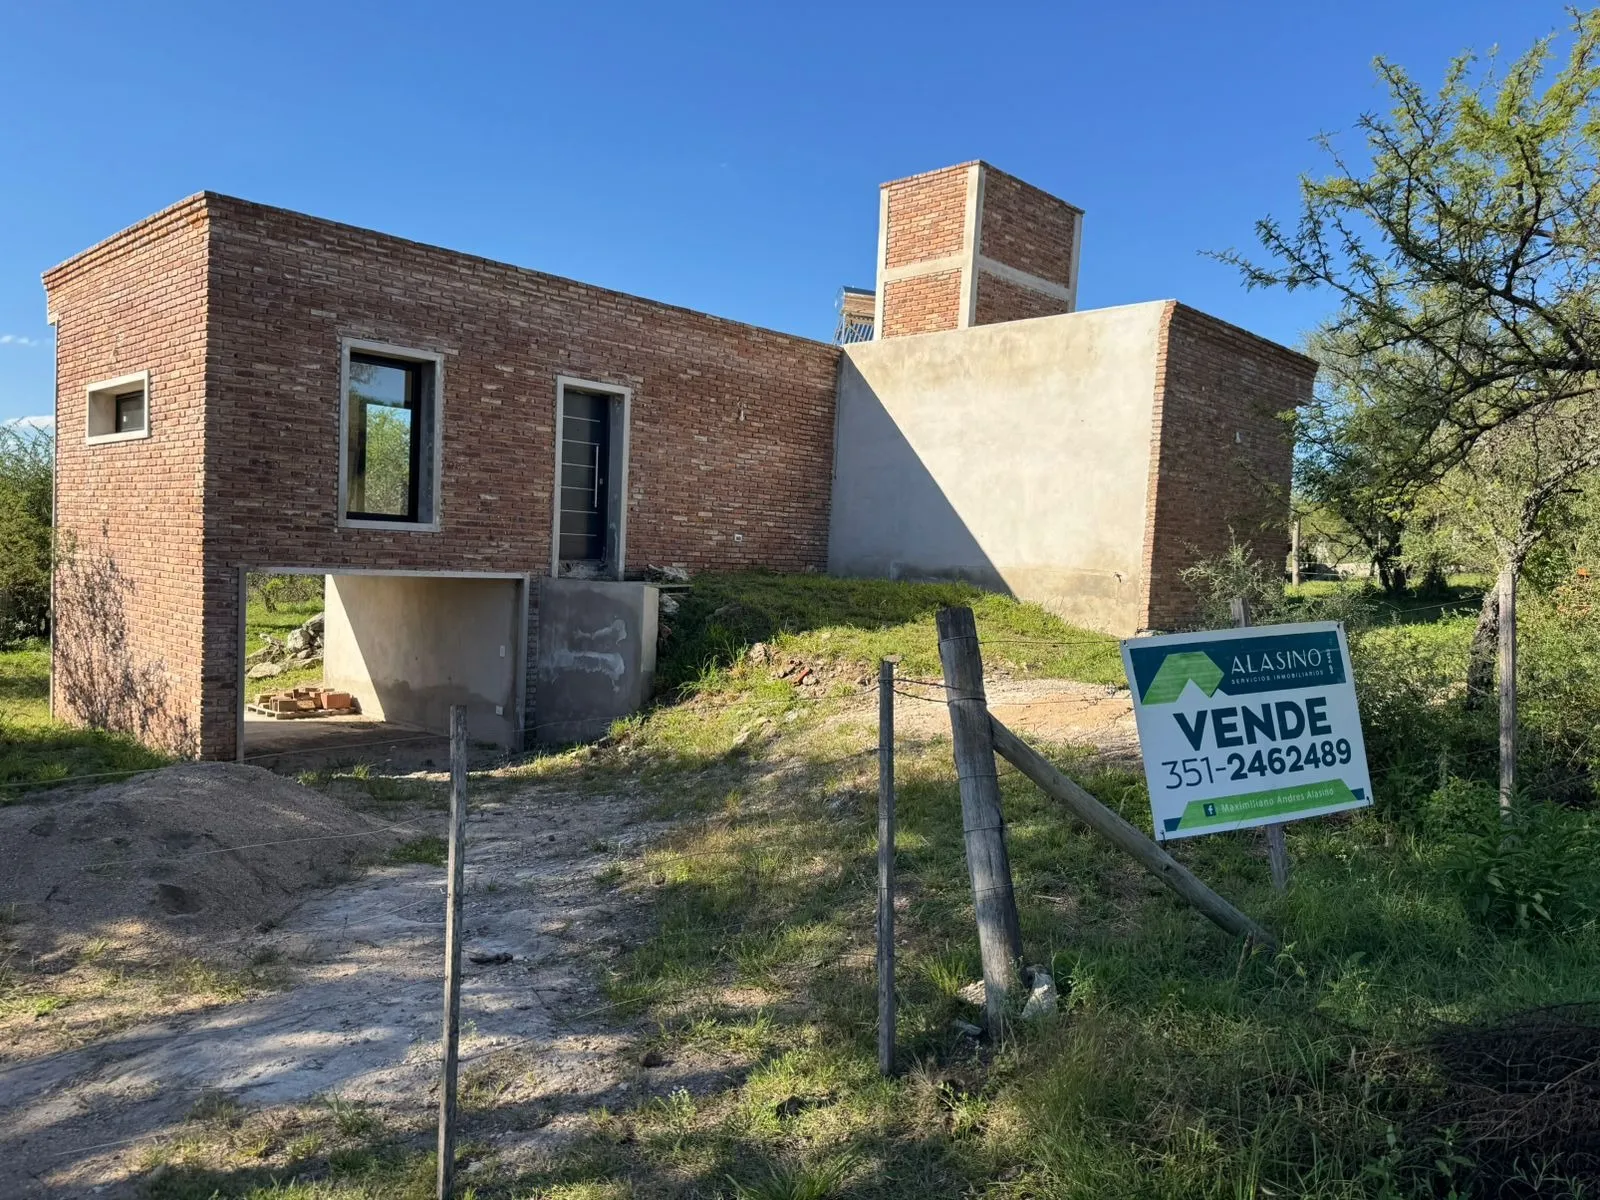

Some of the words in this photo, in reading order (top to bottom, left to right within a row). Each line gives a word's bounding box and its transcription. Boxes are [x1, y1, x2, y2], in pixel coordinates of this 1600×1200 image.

[1231, 648, 1321, 675] ALASINO
[1231, 675, 1271, 685] SERVICIOS
[1273, 670, 1324, 681] INMOBILIARIOS
[1173, 697, 1332, 751] VENDE
[1161, 738, 1352, 789] 351-2462489
[1221, 798, 1274, 813] Maximiliano
[1277, 793, 1305, 804] Andres
[1306, 787, 1334, 799] Alasino
